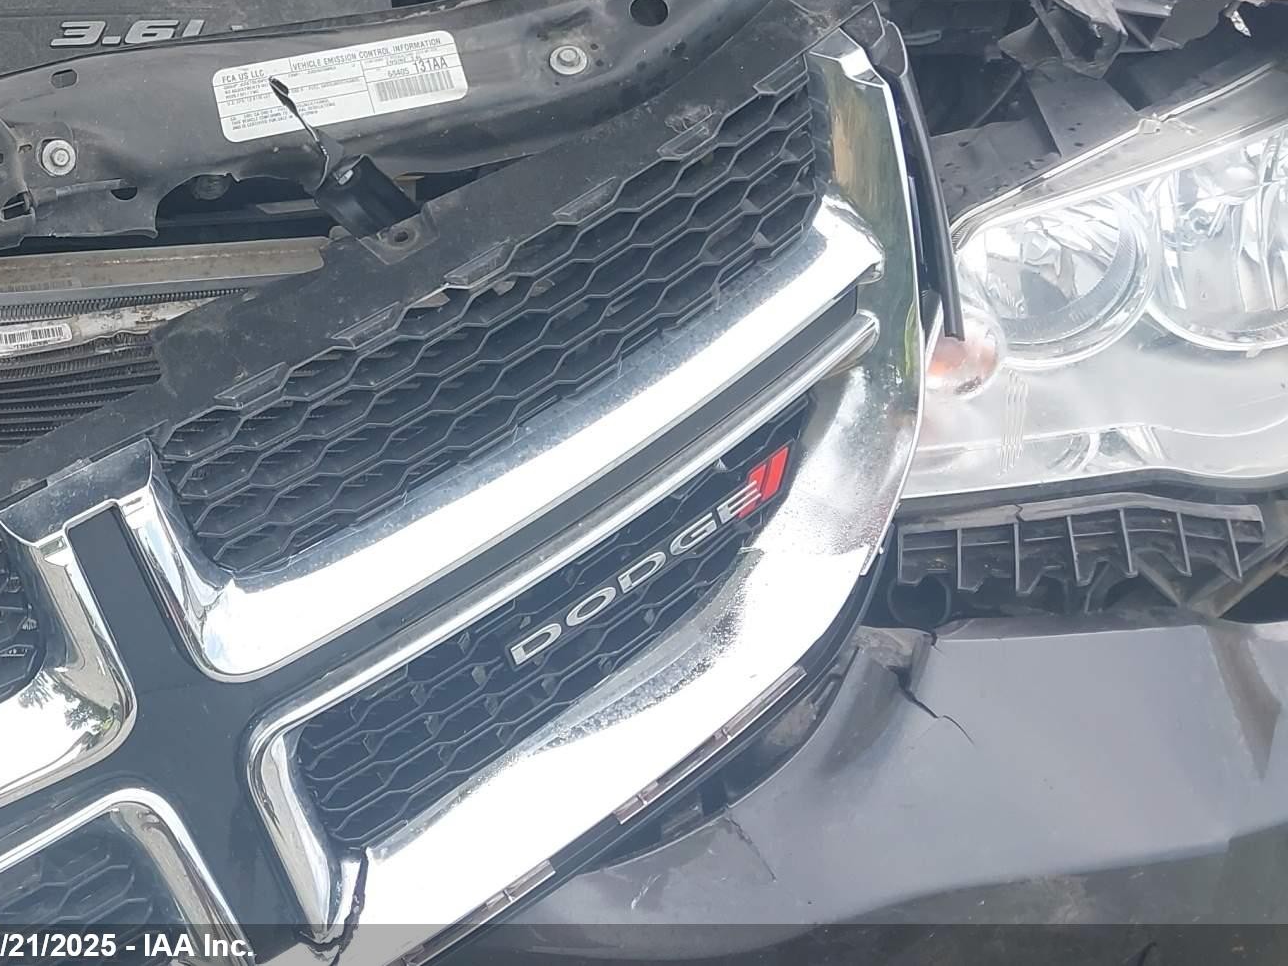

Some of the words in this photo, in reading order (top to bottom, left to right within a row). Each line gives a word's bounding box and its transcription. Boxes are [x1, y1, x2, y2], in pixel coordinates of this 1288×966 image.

[292, 58, 322, 71] VEHICLE
[323, 53, 357, 66] EMISSION
[358, 47, 391, 59] CONTROL
[392, 37, 441, 53] INFORMATION
[412, 55, 448, 75] 131AA
[222, 73, 238, 83] FCA
[239, 72, 249, 81] US
[251, 69, 265, 79] LLC
[510, 478, 762, 666] DODGE
